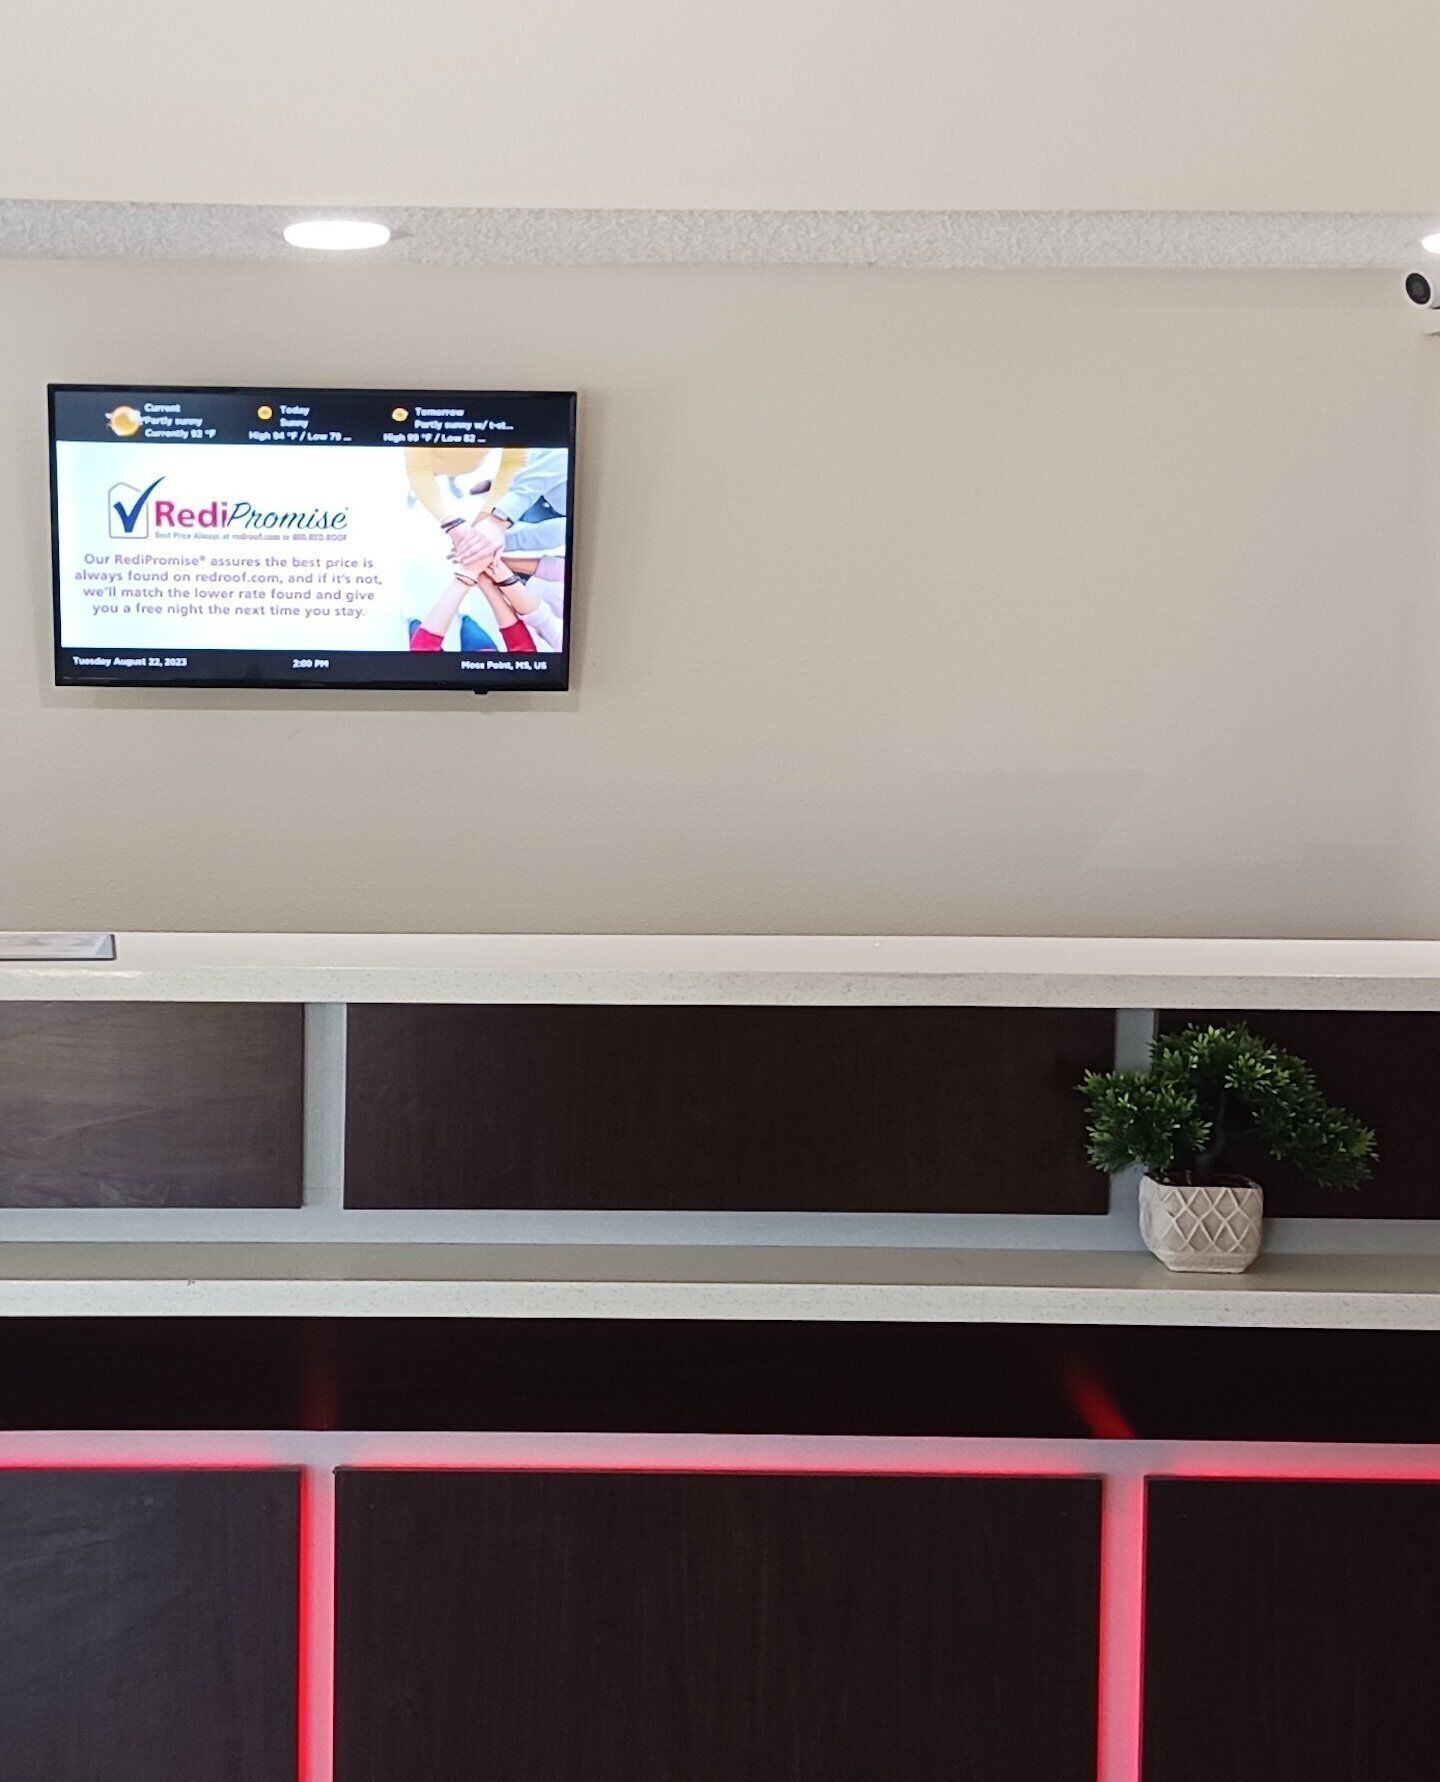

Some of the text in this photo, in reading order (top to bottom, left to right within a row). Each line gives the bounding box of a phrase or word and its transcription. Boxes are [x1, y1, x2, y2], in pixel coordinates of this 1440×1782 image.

[280, 405, 310, 416] Today
[84, 554, 110, 565] Our
[211, 558, 260, 567] assures
[265, 557, 287, 567] the
[292, 557, 321, 568] best
[325, 558, 358, 570] price
[363, 558, 374, 569] is
[75, 570, 123, 582] always
[128, 571, 168, 581] found
[173, 574, 191, 582] on
[288, 573, 313, 584] and
[318, 573, 327, 583] if
[332, 574, 351, 584] it's
[355, 575, 382, 586] not,
[121, 587, 163, 598] match
[168, 588, 191, 598] the
[195, 588, 234, 598] lower
[239, 590, 266, 599] rate
[271, 588, 312, 600] found
[316, 590, 342, 600] and
[346, 590, 375, 602] give
[92, 602, 366, 619] you a free night the next time you stay.
[314, 659, 330, 668] PM
